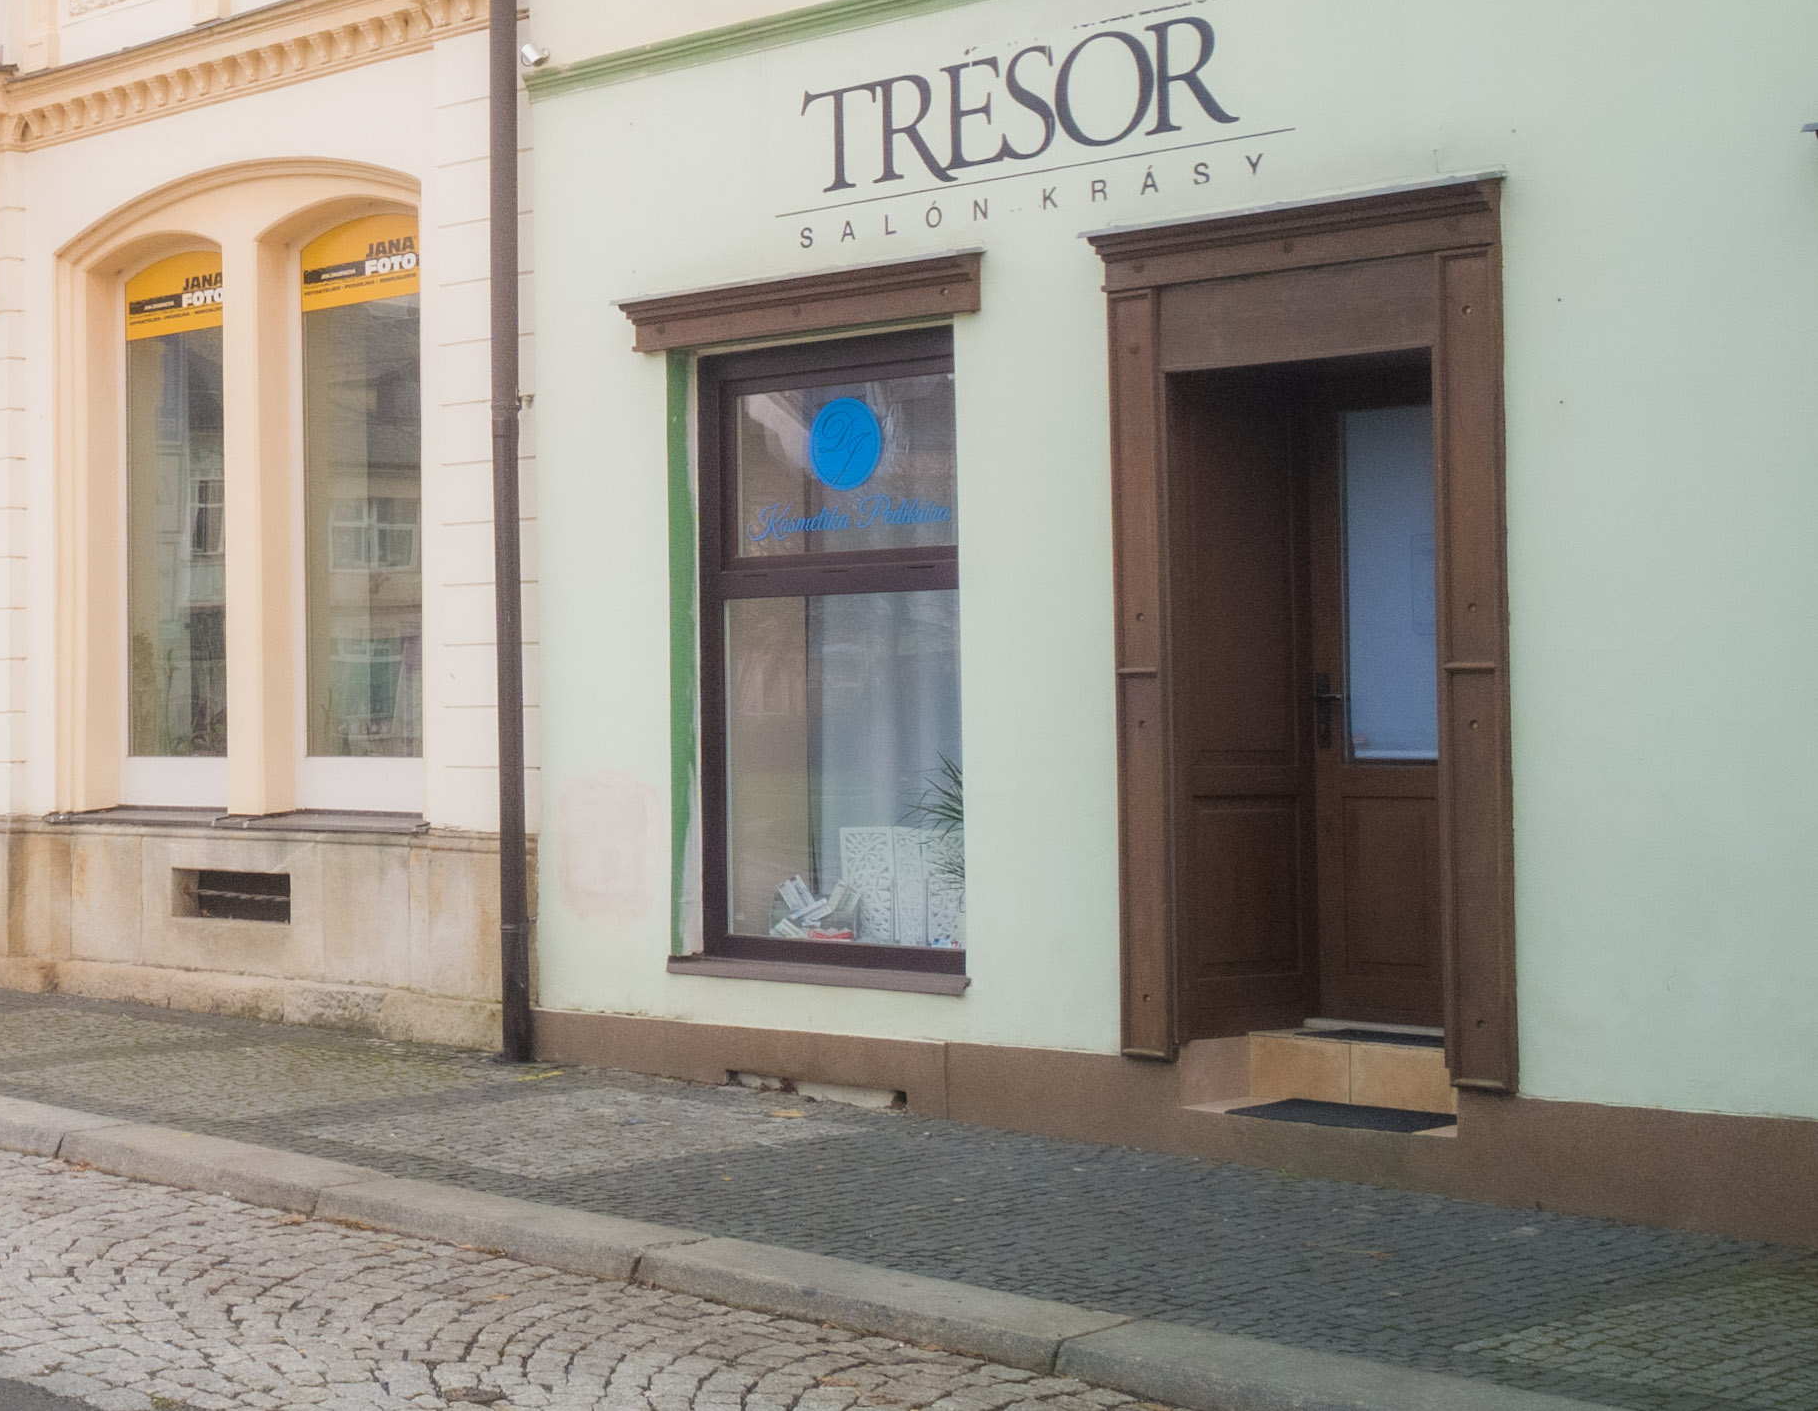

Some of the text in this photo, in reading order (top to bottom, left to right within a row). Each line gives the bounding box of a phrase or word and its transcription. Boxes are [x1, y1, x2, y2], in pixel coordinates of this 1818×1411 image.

[799, 152, 1263, 249] SALÓN KRÁSY
[366, 236, 416, 258] JANA
[365, 252, 417, 276] FOTO
[182, 271, 222, 291] JANA
[182, 287, 223, 308] FOTO
[747, 493, 951, 541] Kosmetika Pedikúra
